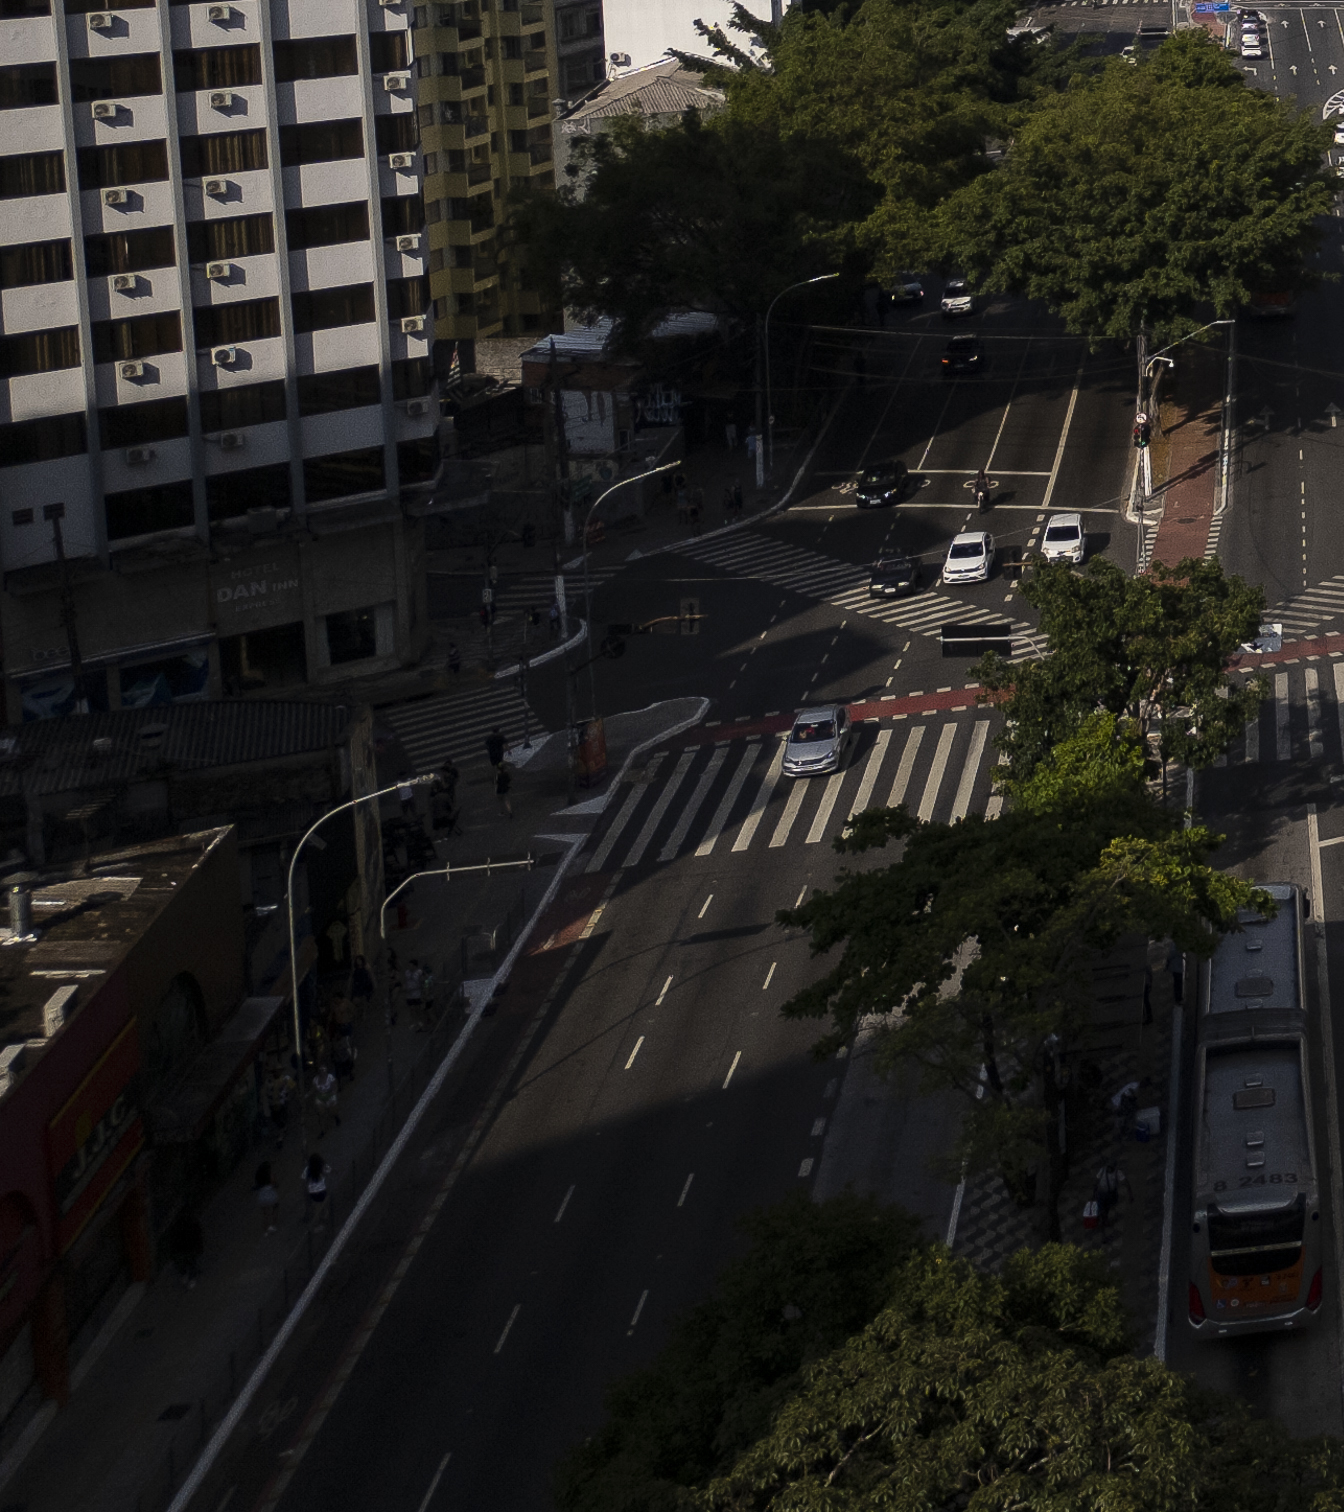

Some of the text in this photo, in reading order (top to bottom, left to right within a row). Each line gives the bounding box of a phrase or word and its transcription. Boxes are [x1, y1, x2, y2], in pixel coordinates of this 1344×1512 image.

[231, 562, 280, 579] HOTEL
[217, 579, 299, 603] DAN INN
[1239, 1172, 1298, 1188] 2483
